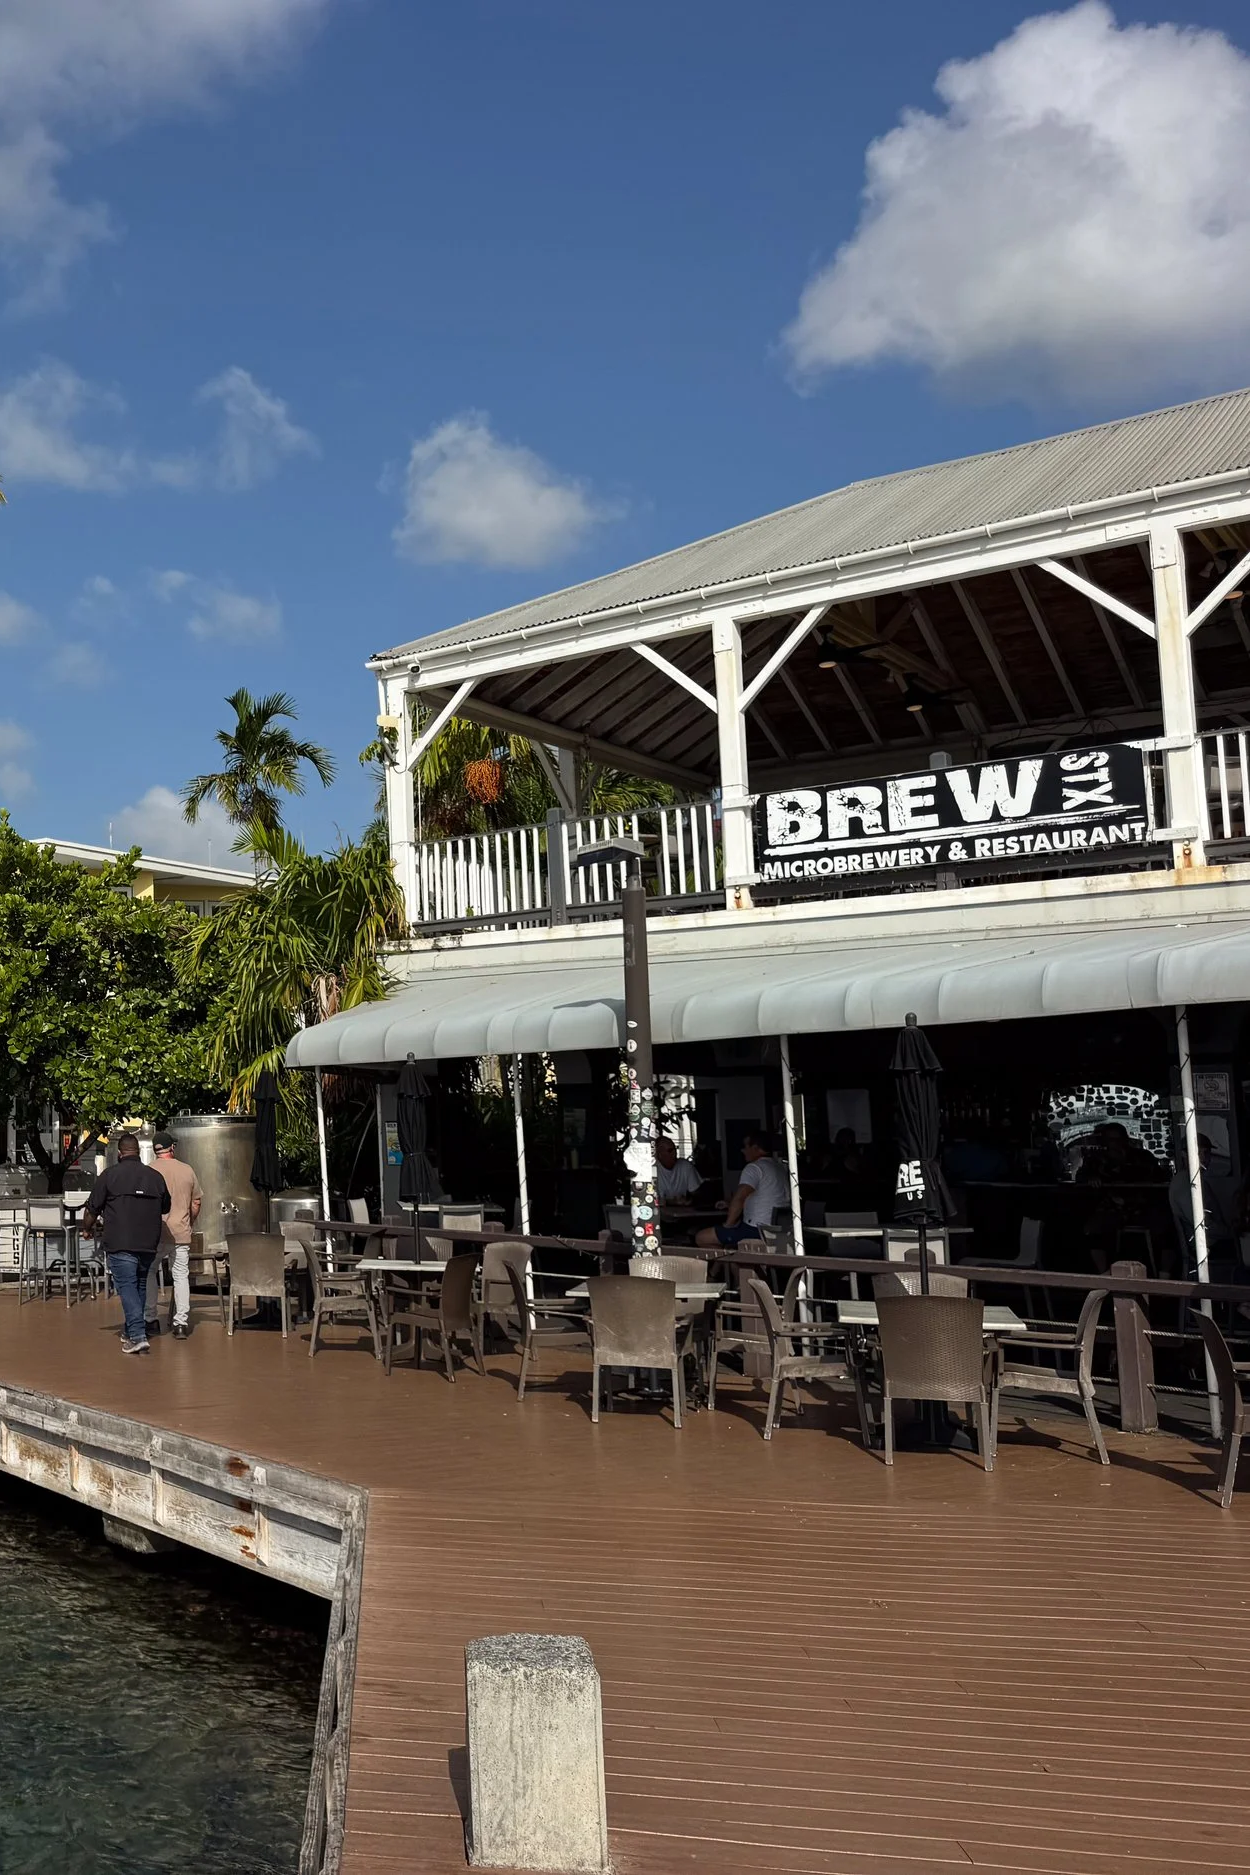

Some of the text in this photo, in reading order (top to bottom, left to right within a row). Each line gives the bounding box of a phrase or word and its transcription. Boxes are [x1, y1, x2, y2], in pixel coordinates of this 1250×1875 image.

[766, 759, 1044, 846] BREW
[1059, 751, 1114, 811] STX
[762, 822, 1146, 881] MICROBREWERY & RESTAURANT
